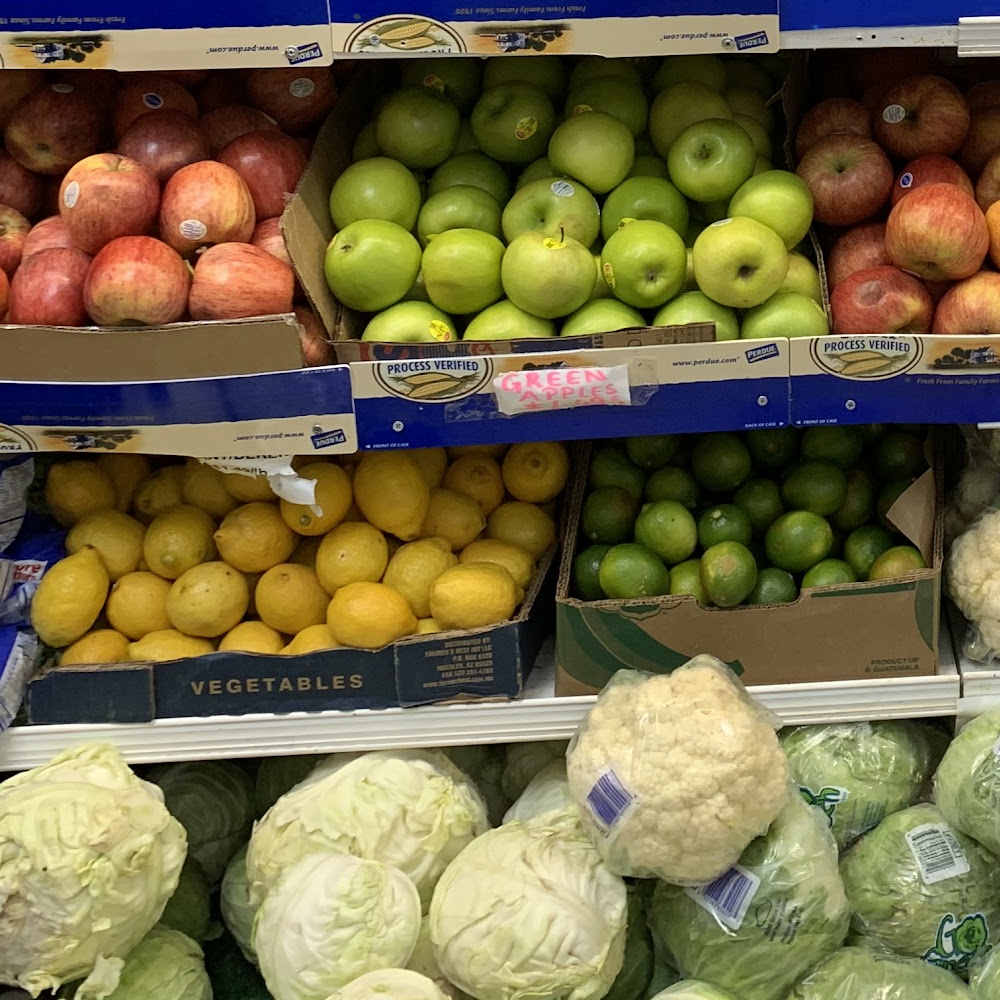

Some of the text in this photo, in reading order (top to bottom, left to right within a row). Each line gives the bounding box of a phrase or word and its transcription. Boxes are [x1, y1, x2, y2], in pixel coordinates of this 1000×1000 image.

[739, 36, 767, 48] PERDUE
[747, 345, 776, 358] PERDUE
[824, 340, 911, 352] PROCESS VERIFIED
[387, 360, 479, 374] PROCESS VERIFIED
[501, 369, 607, 394] GREEN
[518, 384, 618, 402] APPLES
[316, 434, 344, 447] PERDUE
[873, 664, 920, 673] GUATEMALA
[190, 674, 364, 696] VEGETABLES
